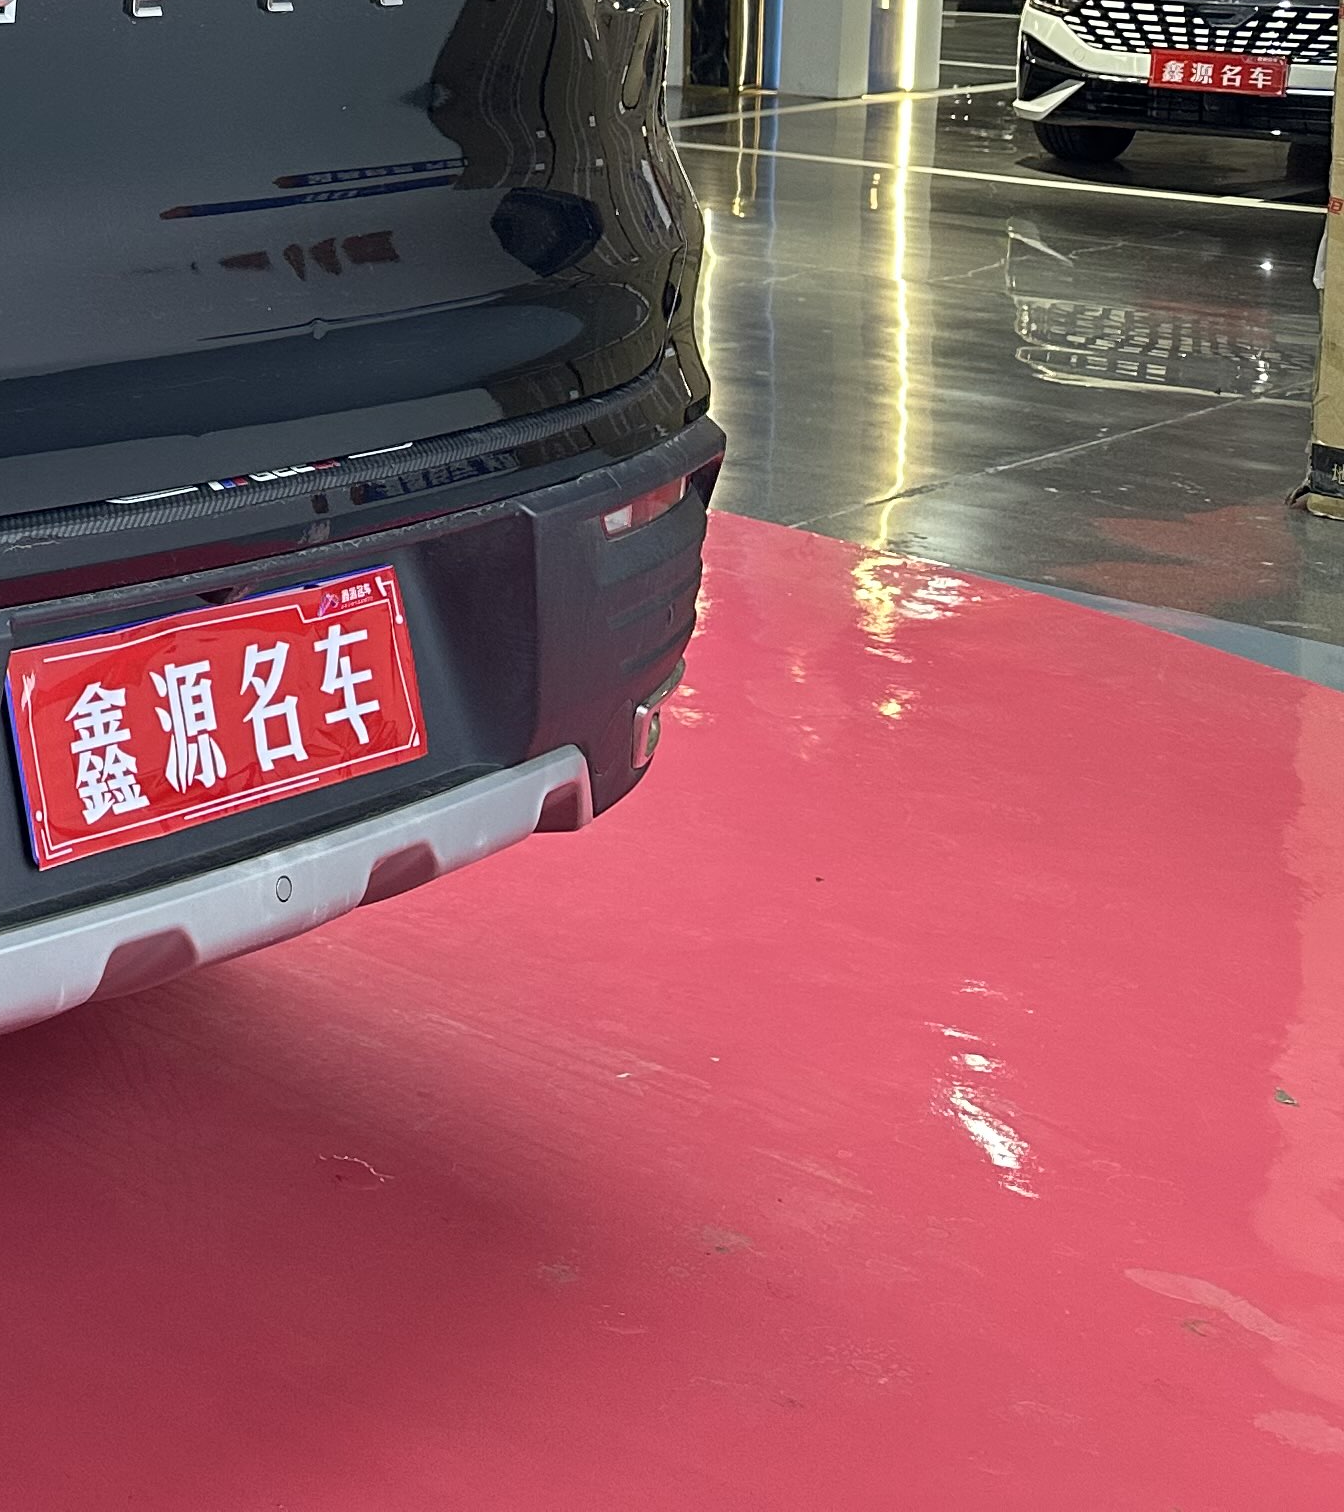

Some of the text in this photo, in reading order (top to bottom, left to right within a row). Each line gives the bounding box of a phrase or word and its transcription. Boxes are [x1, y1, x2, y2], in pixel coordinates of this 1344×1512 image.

[1161, 59, 1274, 90] 鑫源名车
[65, 624, 381, 825] 鑫源名车
